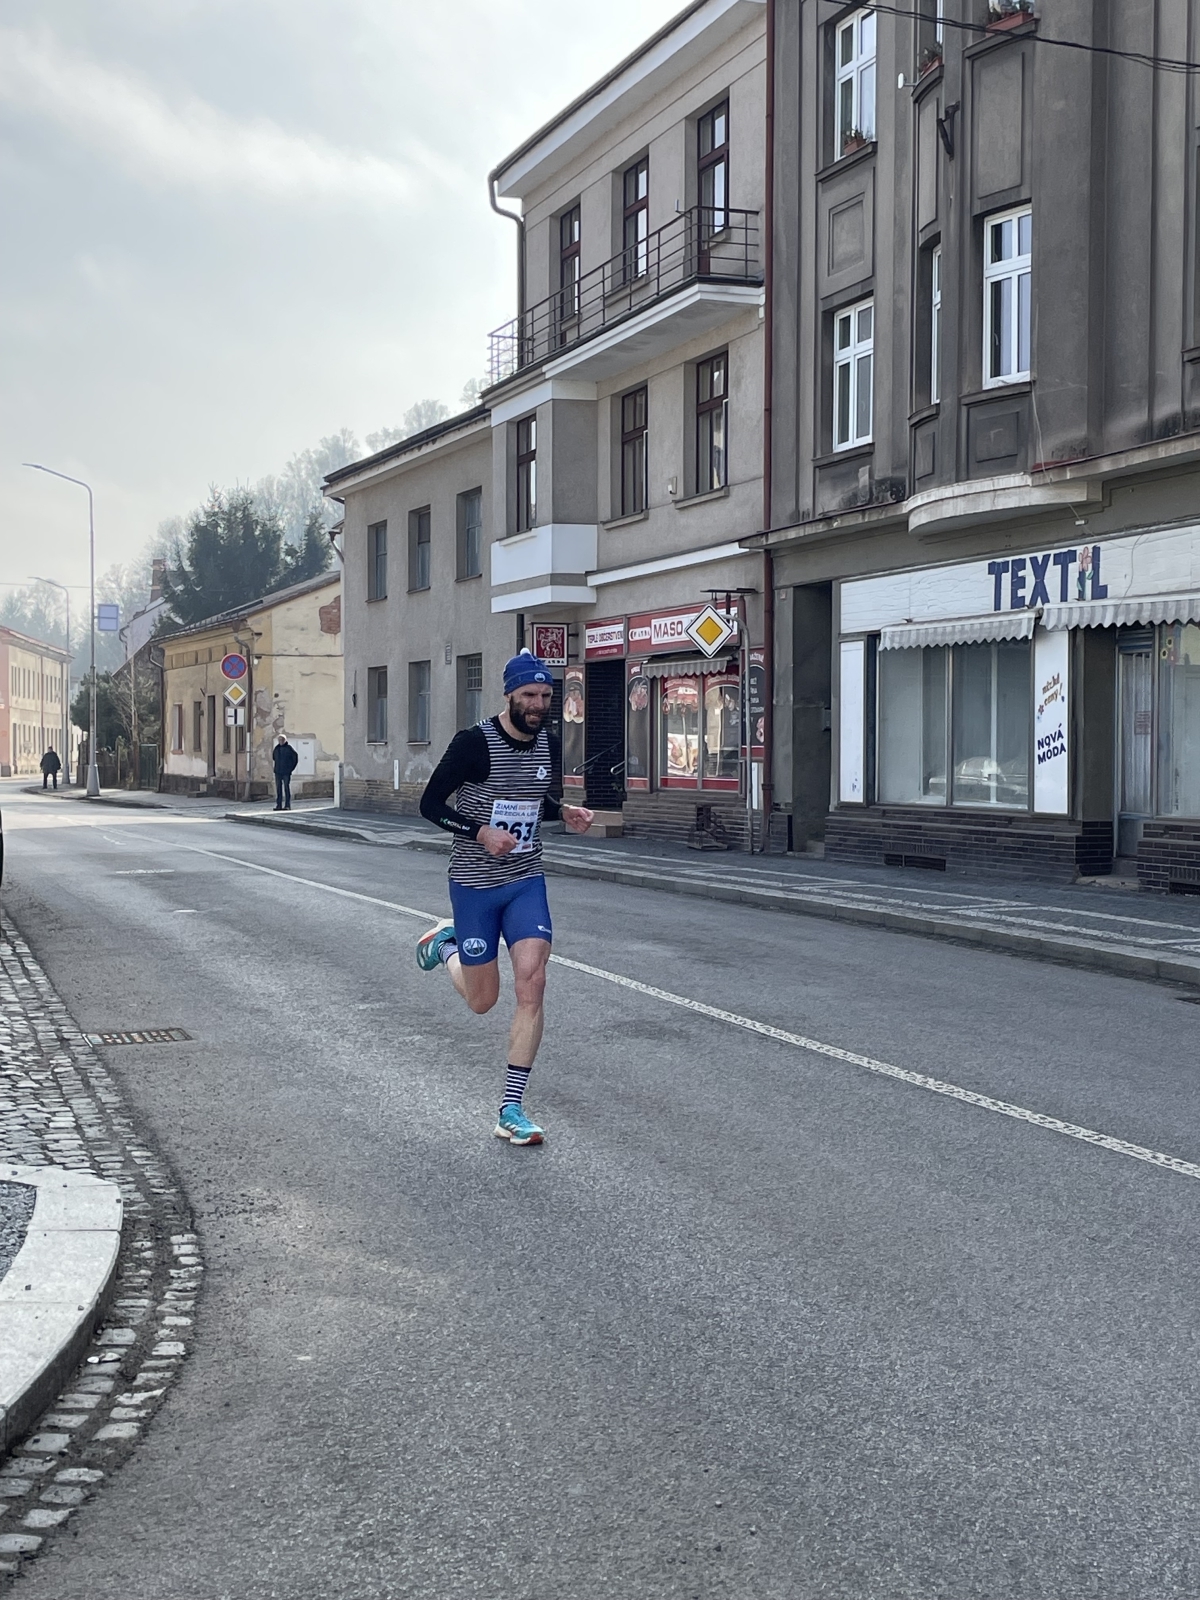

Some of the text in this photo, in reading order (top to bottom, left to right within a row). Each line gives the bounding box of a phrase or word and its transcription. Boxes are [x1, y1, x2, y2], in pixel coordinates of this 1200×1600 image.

[988, 545, 1108, 611] TEXTIL
[653, 620, 683, 640] MASO
[1037, 723, 1064, 750] NOVÁ
[1037, 743, 1066, 765] MODA
